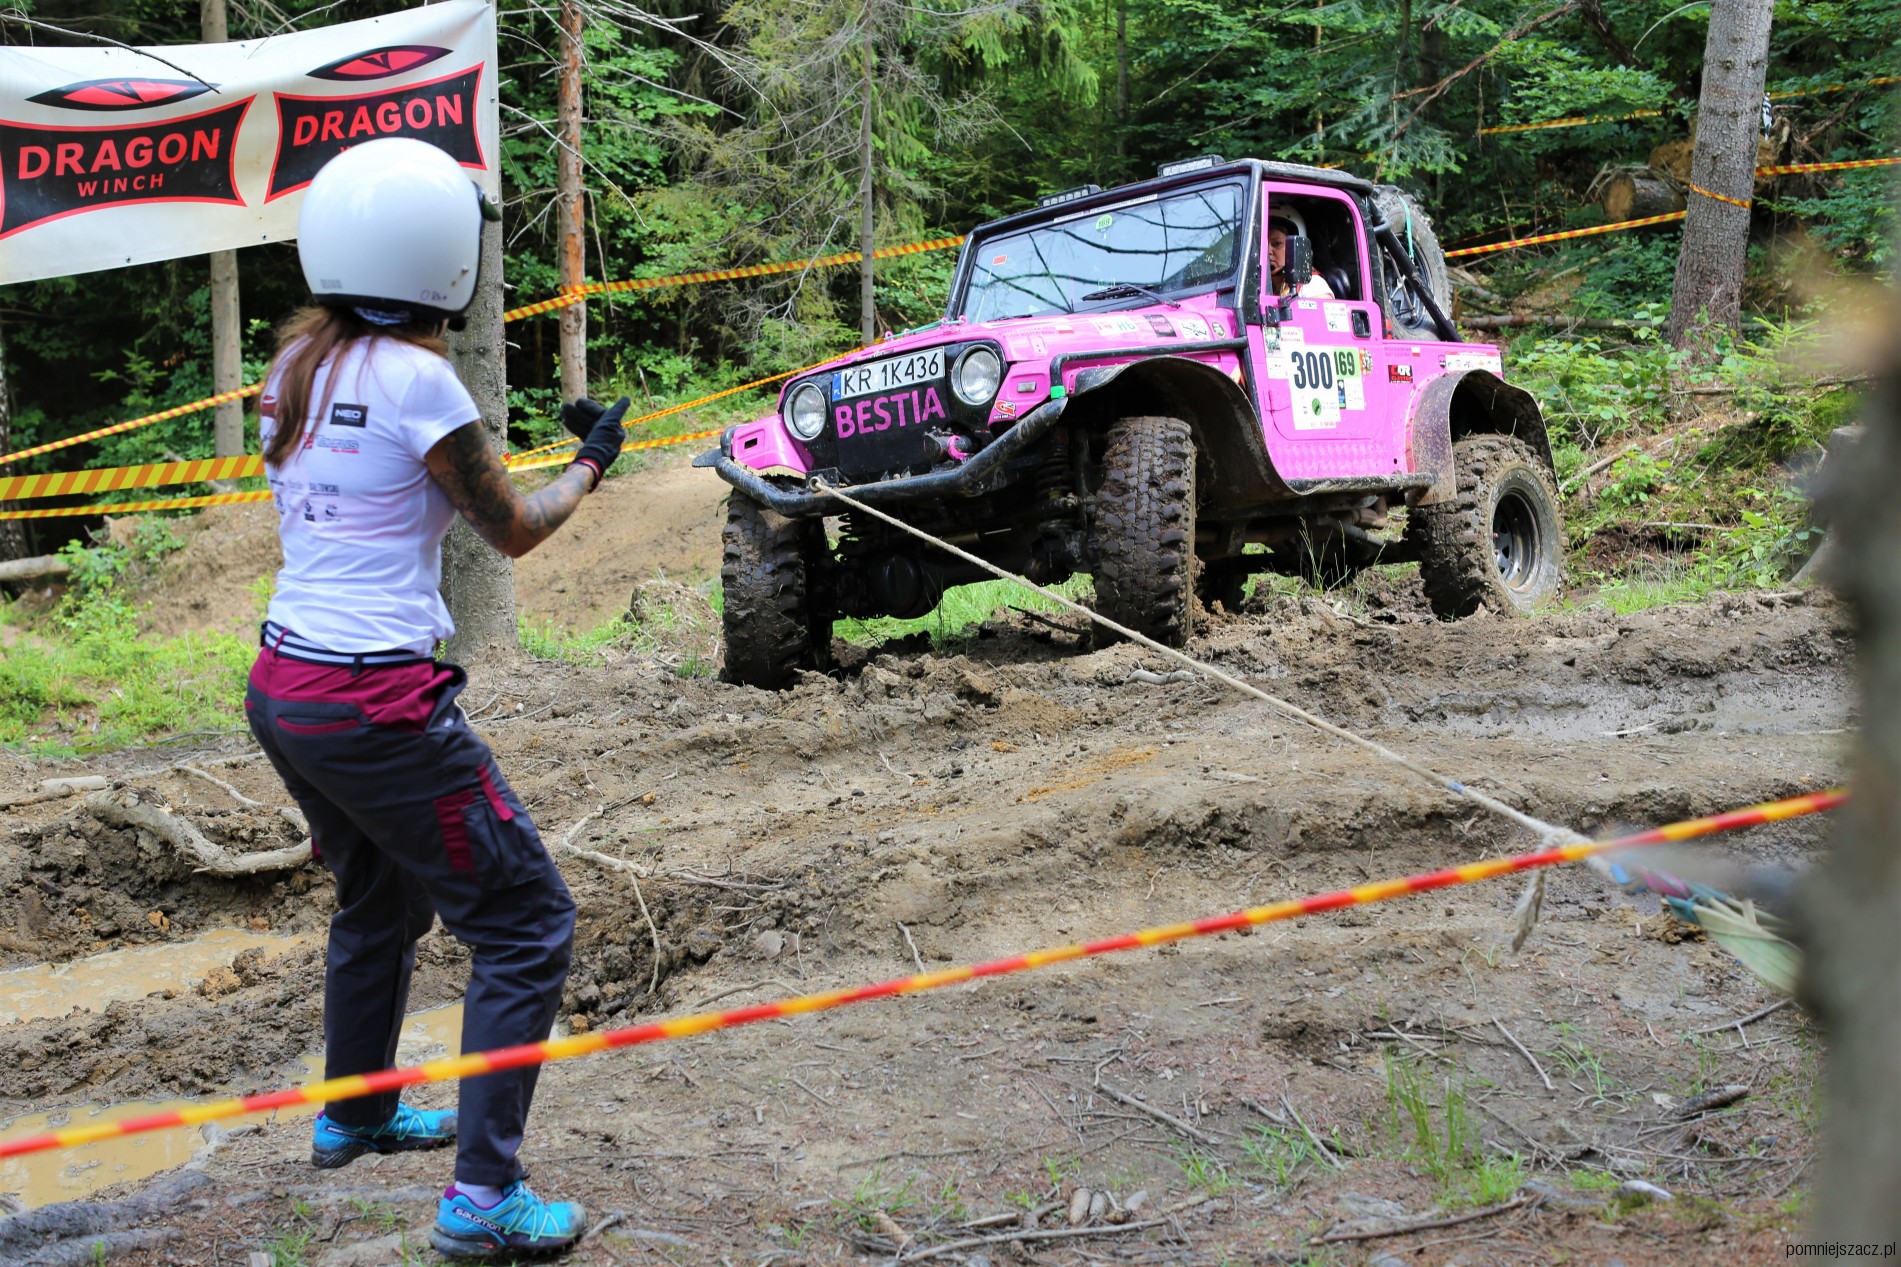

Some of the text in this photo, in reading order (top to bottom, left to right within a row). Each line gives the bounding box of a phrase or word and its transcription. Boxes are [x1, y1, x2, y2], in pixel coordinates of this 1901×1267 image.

[293, 93, 464, 147] DRAGON
[17, 127, 221, 180] DRAGON
[77, 173, 164, 198] WINCH
[843, 352, 939, 395] KR 1K436
[1291, 351, 1333, 390] 300
[1333, 351, 1356, 376] 169
[334, 408, 362, 419] NEO
[834, 387, 946, 439] BESTIA
